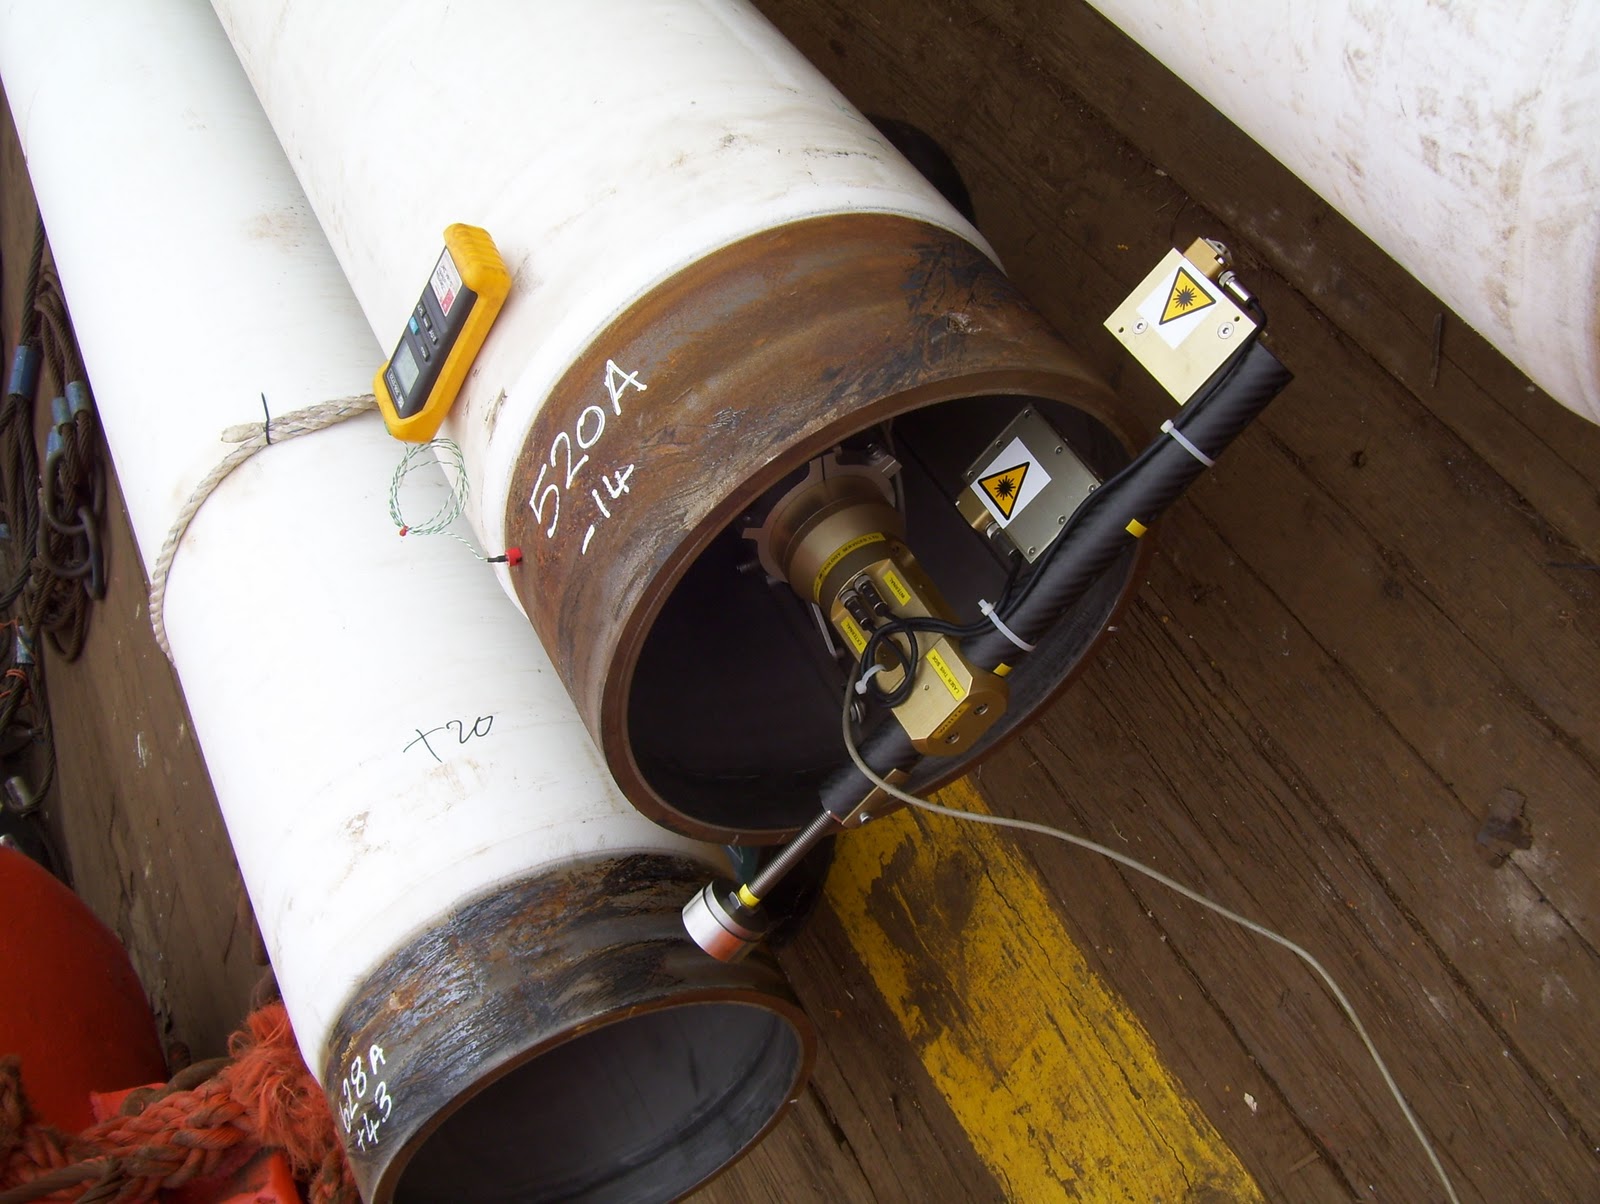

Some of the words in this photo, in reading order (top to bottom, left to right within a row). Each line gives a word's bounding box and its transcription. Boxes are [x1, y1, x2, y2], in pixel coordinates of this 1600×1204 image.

[529, 359, 648, 539] 520A
[845, 622, 863, 646] EXTERNAL
[939, 666, 950, 679] THIS
[947, 677, 960, 694] LASER
